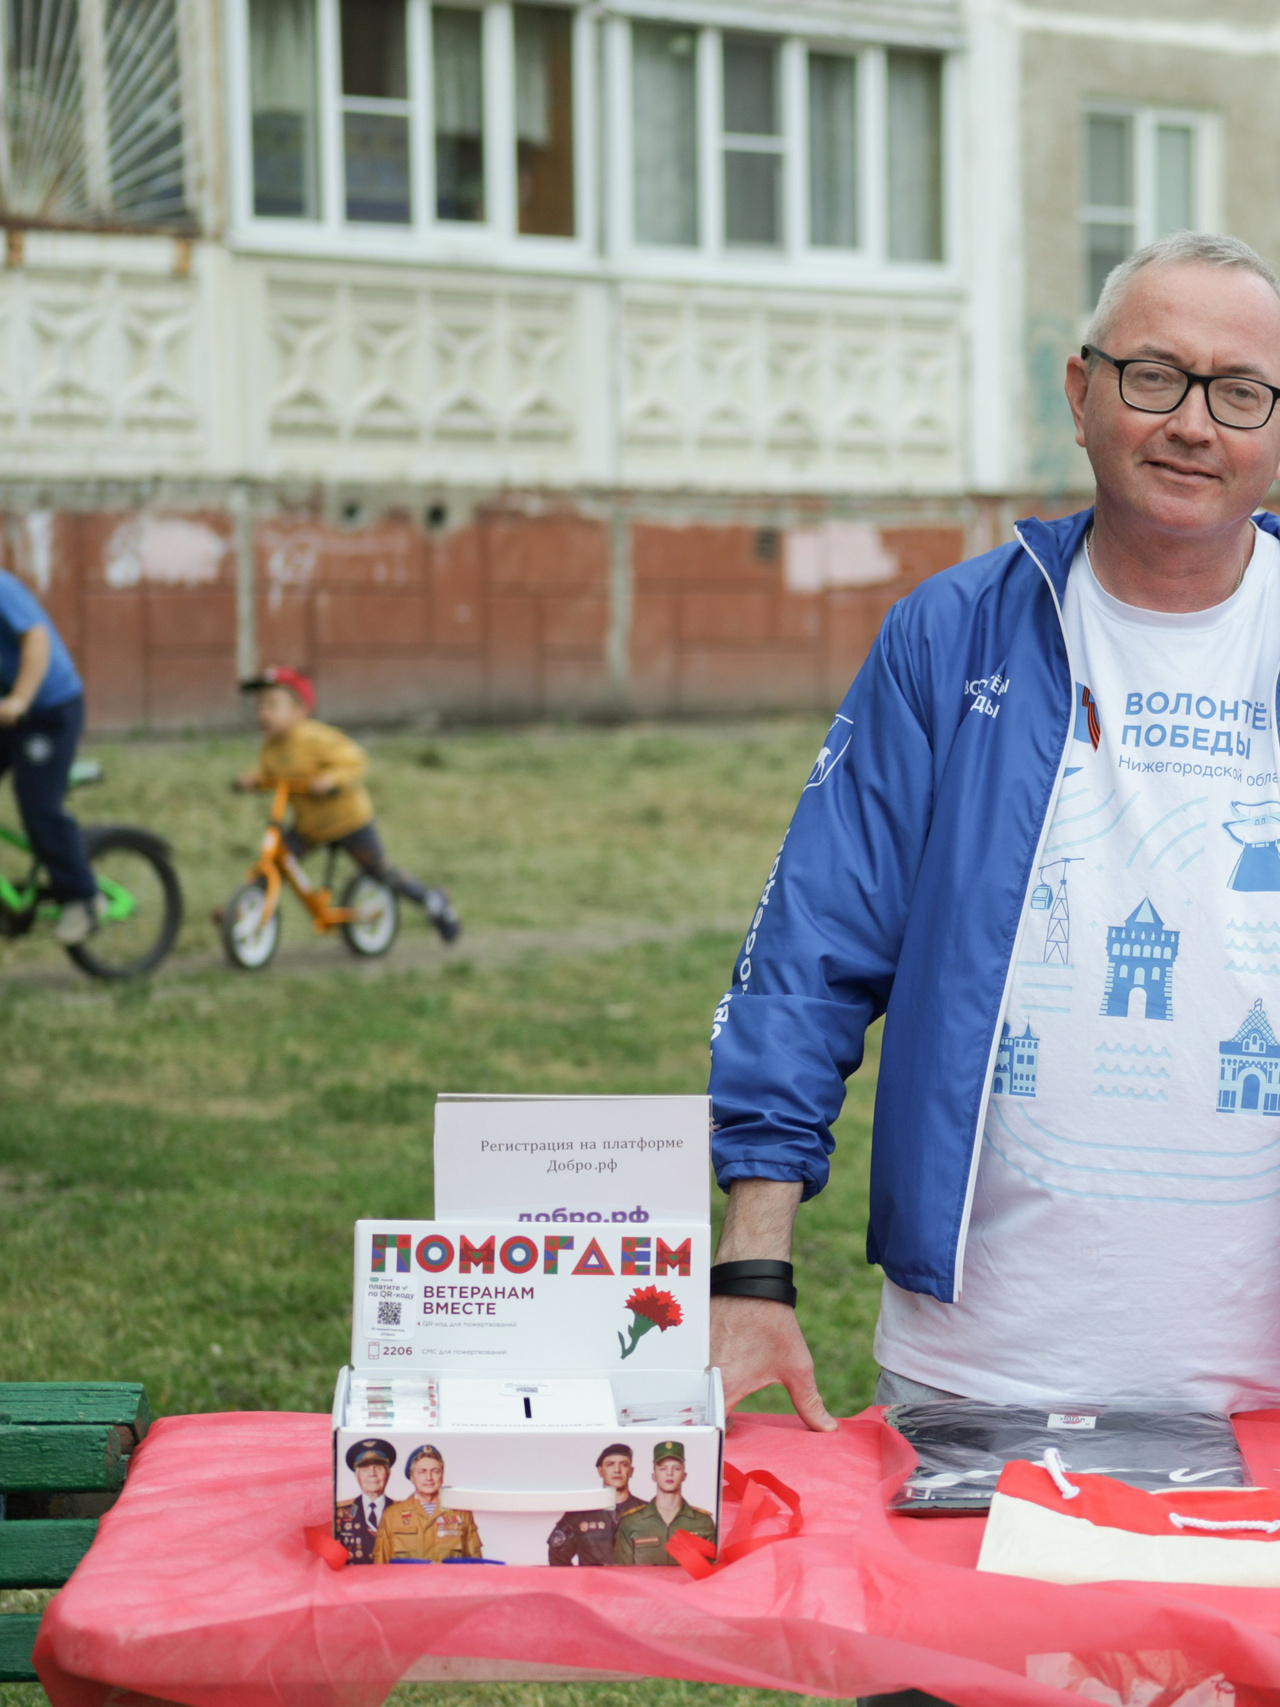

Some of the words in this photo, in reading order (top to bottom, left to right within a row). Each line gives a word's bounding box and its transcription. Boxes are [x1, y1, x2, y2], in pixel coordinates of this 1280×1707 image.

[1124, 691, 1273, 731] ВОЛОНТЁ
[1121, 723, 1252, 760] ПОБЕДЫ
[1118, 754, 1243, 784] Нижегородской
[480, 1139, 574, 1154] Регистрация
[579, 1141, 597, 1150] на
[602, 1136, 684, 1152] платформе
[371, 1234, 692, 1277] ПОМОГАЕМ
[380, 1290, 415, 1300] QR-коду
[423, 1285, 535, 1299] ВЕТЕРАНАМ
[422, 1302, 497, 1315] ВМЕСТЕ
[382, 1346, 413, 1356] 2206
